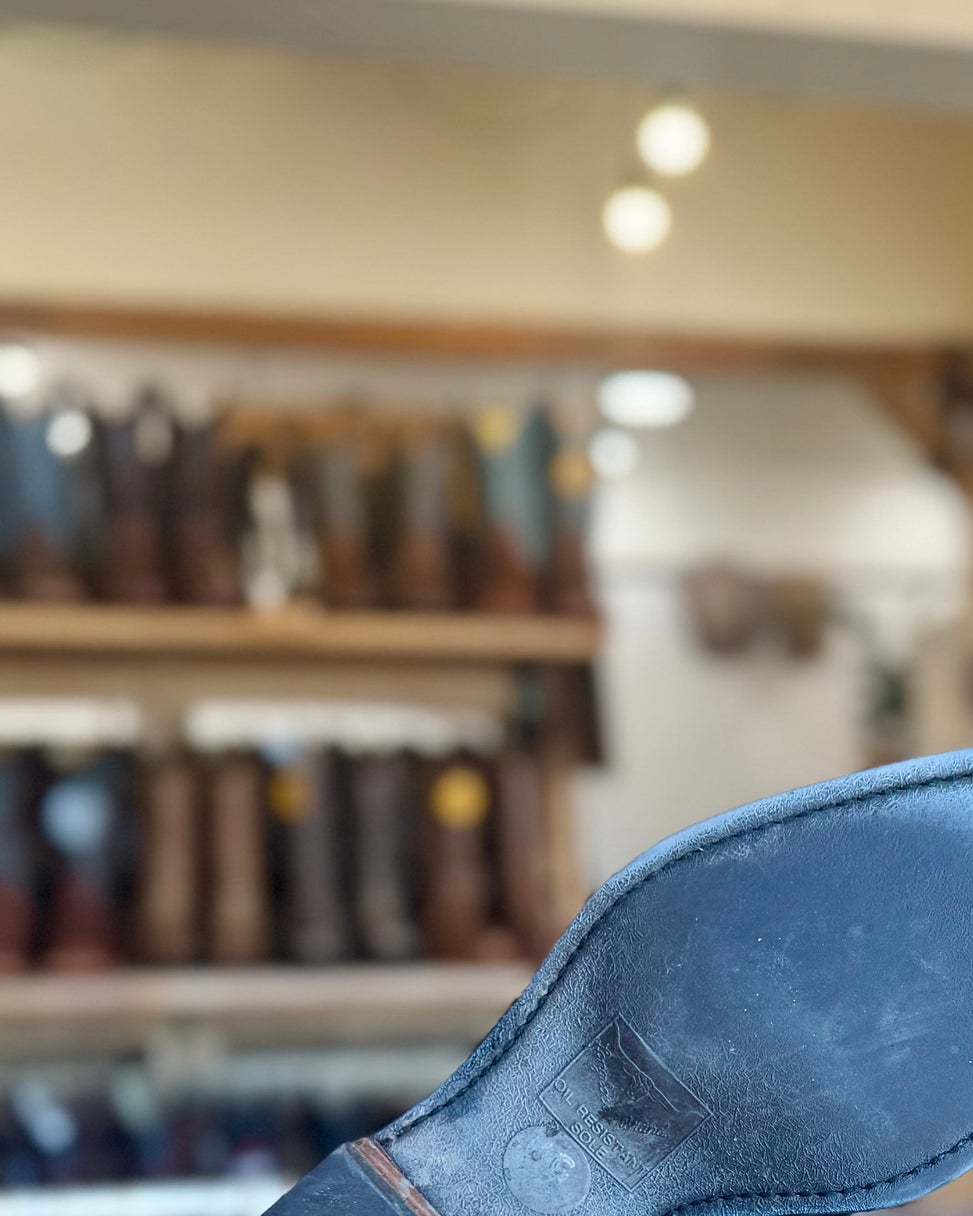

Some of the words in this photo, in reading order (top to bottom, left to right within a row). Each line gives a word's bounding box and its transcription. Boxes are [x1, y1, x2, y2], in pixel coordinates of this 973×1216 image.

[554, 1078, 574, 1106] OIL
[576, 1103, 651, 1177] RESISTANT
[570, 1121, 609, 1160] SOLE
